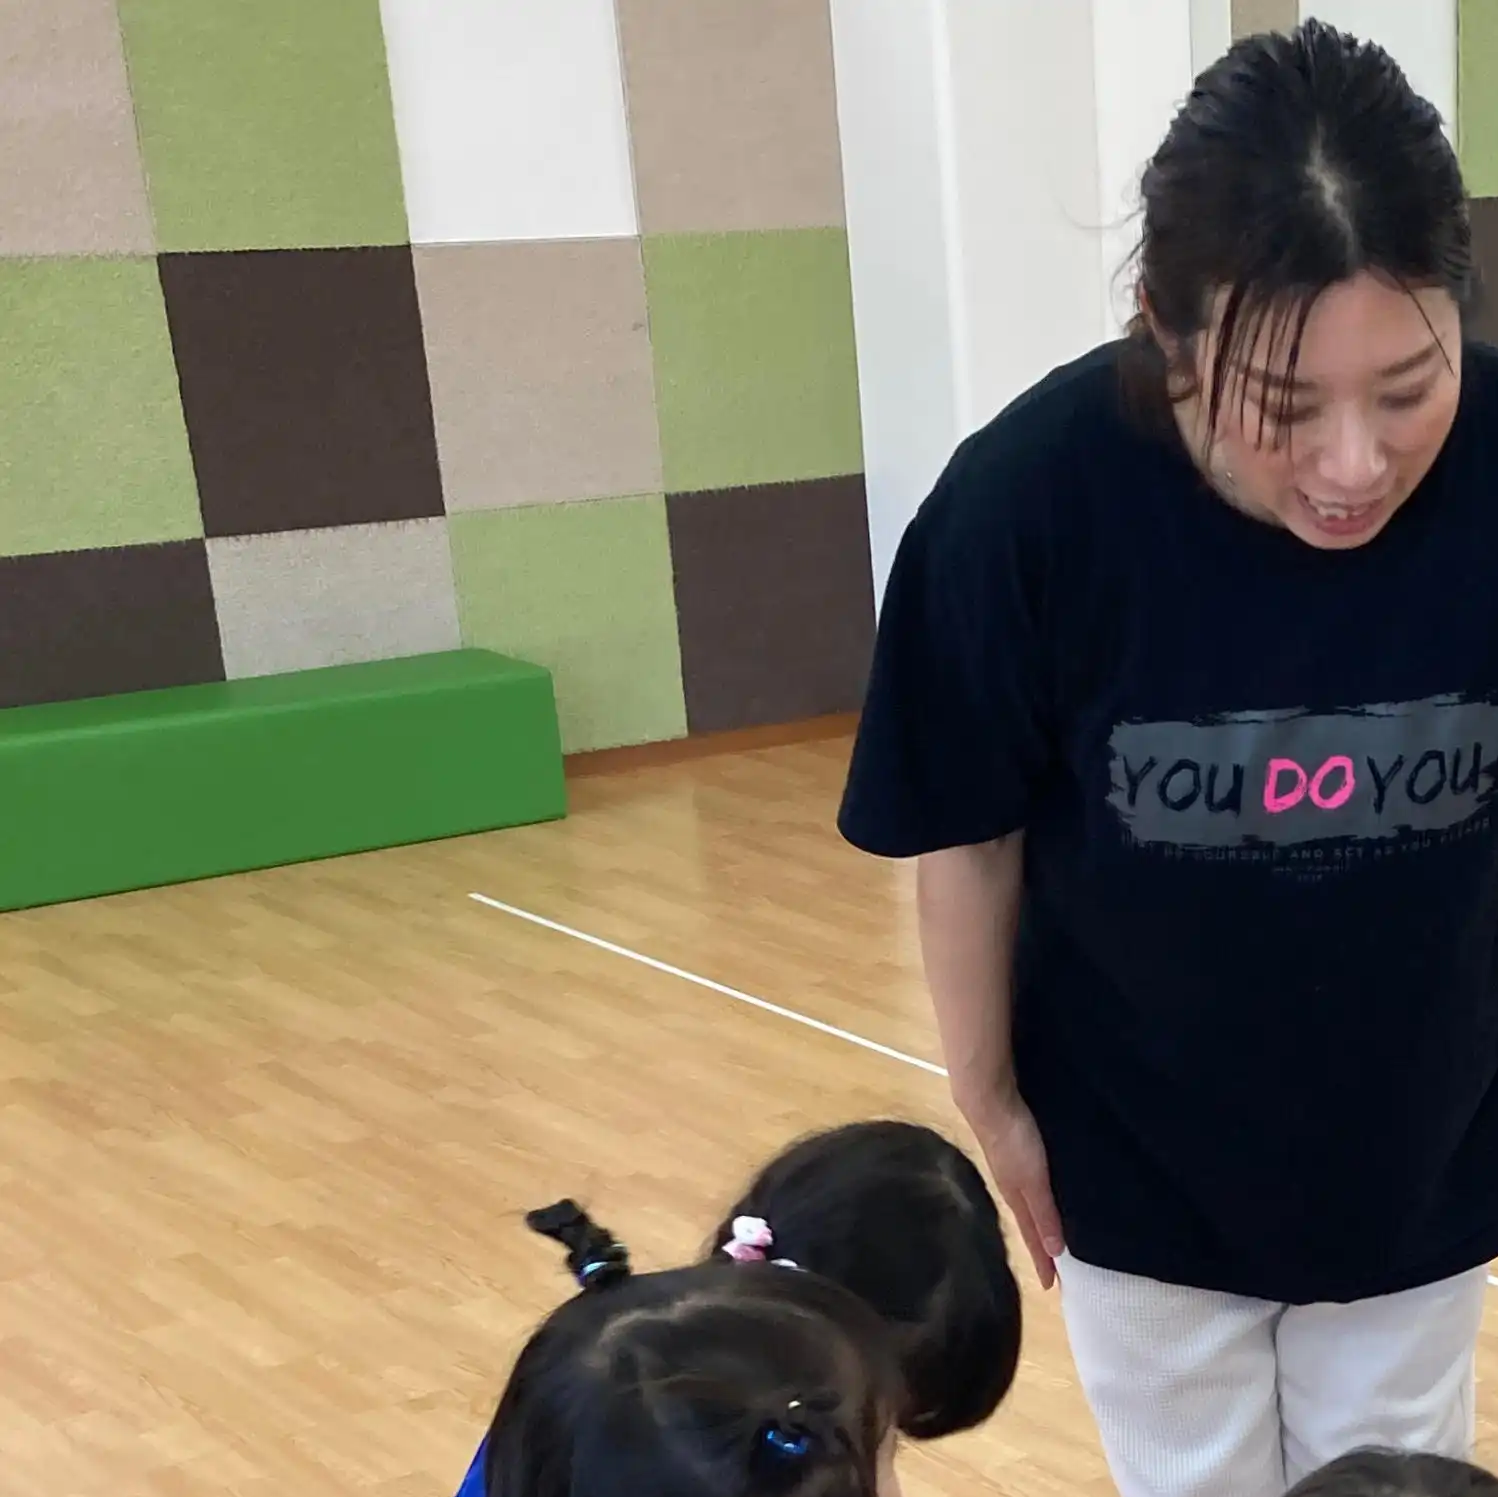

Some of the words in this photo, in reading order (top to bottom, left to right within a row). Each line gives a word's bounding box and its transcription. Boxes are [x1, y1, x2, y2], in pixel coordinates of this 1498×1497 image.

[1123, 755, 1244, 817] YOU
[1263, 755, 1356, 814] DO
[1367, 743, 1482, 815] YOU
